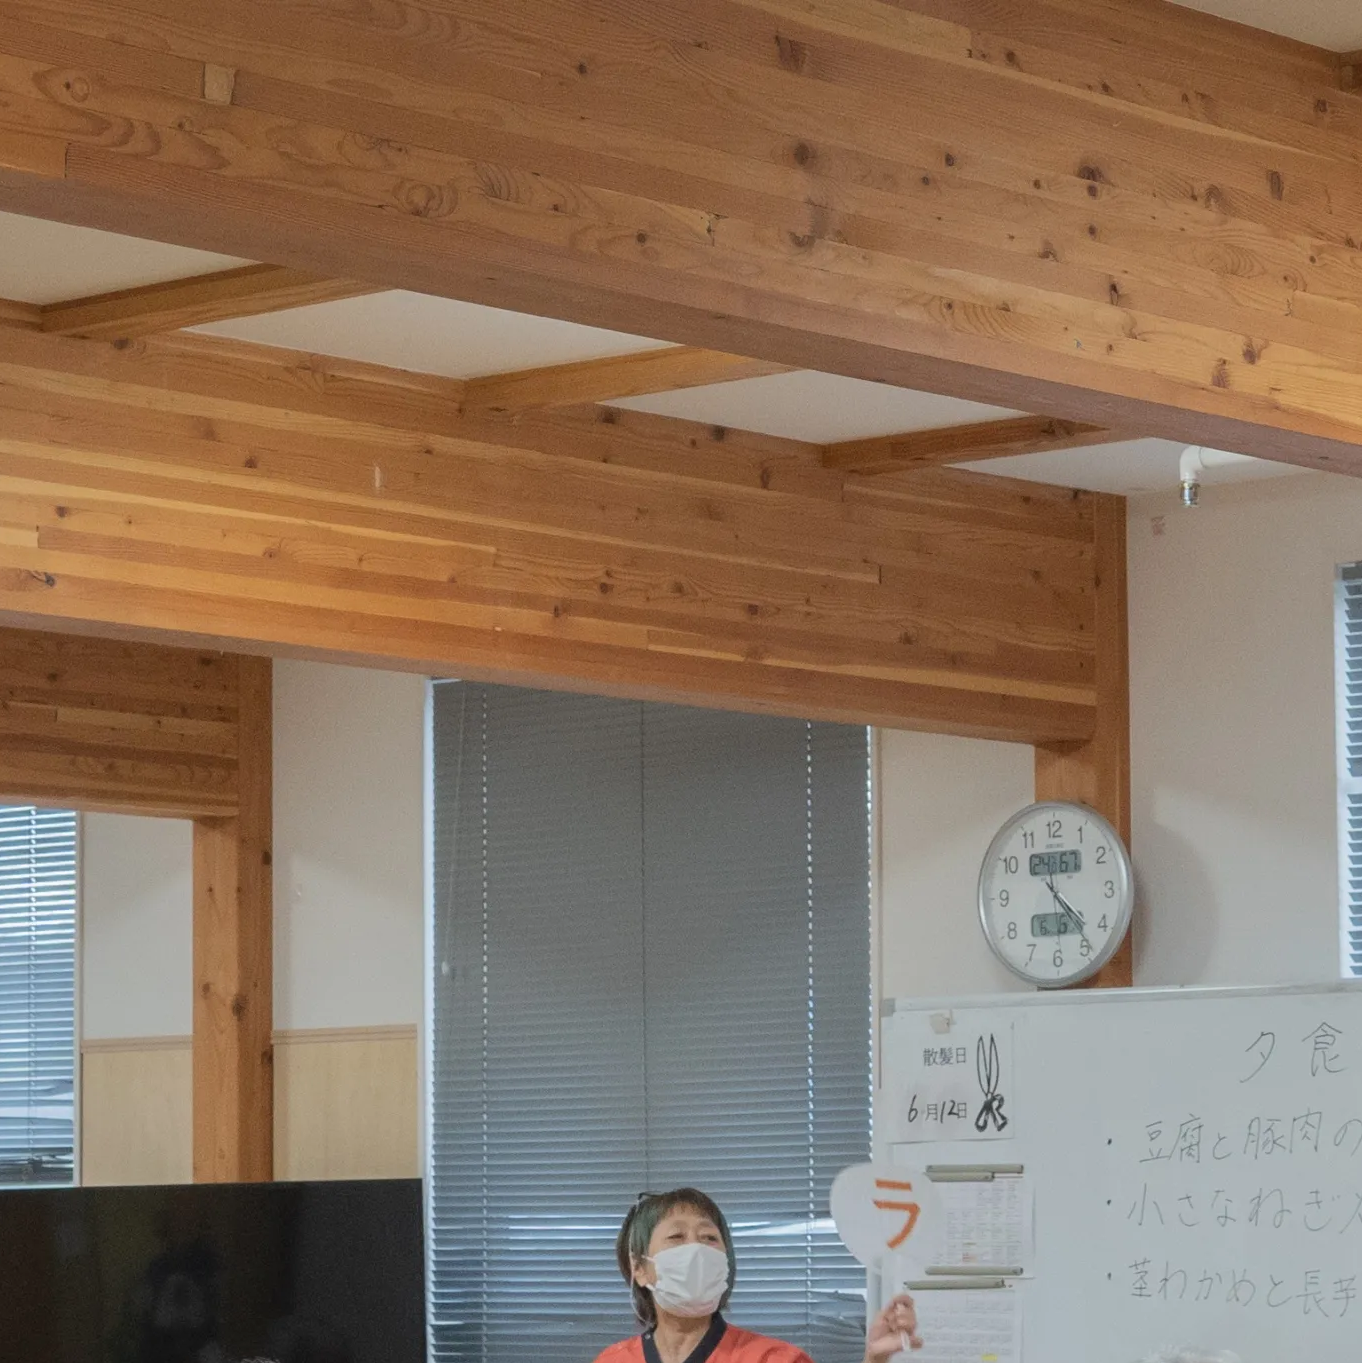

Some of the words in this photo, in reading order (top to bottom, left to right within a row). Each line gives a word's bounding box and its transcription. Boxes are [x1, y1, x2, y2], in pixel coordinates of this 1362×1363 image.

[1046, 820, 1062, 838] 12
[1077, 826, 1083, 844] 1
[1023, 831, 1034, 849] 11
[1096, 847, 1106, 864] 2
[1003, 856, 1018, 874] 10
[1104, 880, 1115, 898] 3
[999, 890, 1009, 907] 9
[1007, 922, 1017, 939] 8
[1097, 914, 1108, 932] 4
[1026, 944, 1037, 962] 7
[1080, 938, 1091, 957] 5
[1053, 950, 1063, 967] 6
[923, 1047, 967, 1066] 散髪日
[1239, 1022, 1349, 1083] 夕食
[908, 1094, 967, 1123] 6月12日
[872, 1178, 921, 1249] ラ
